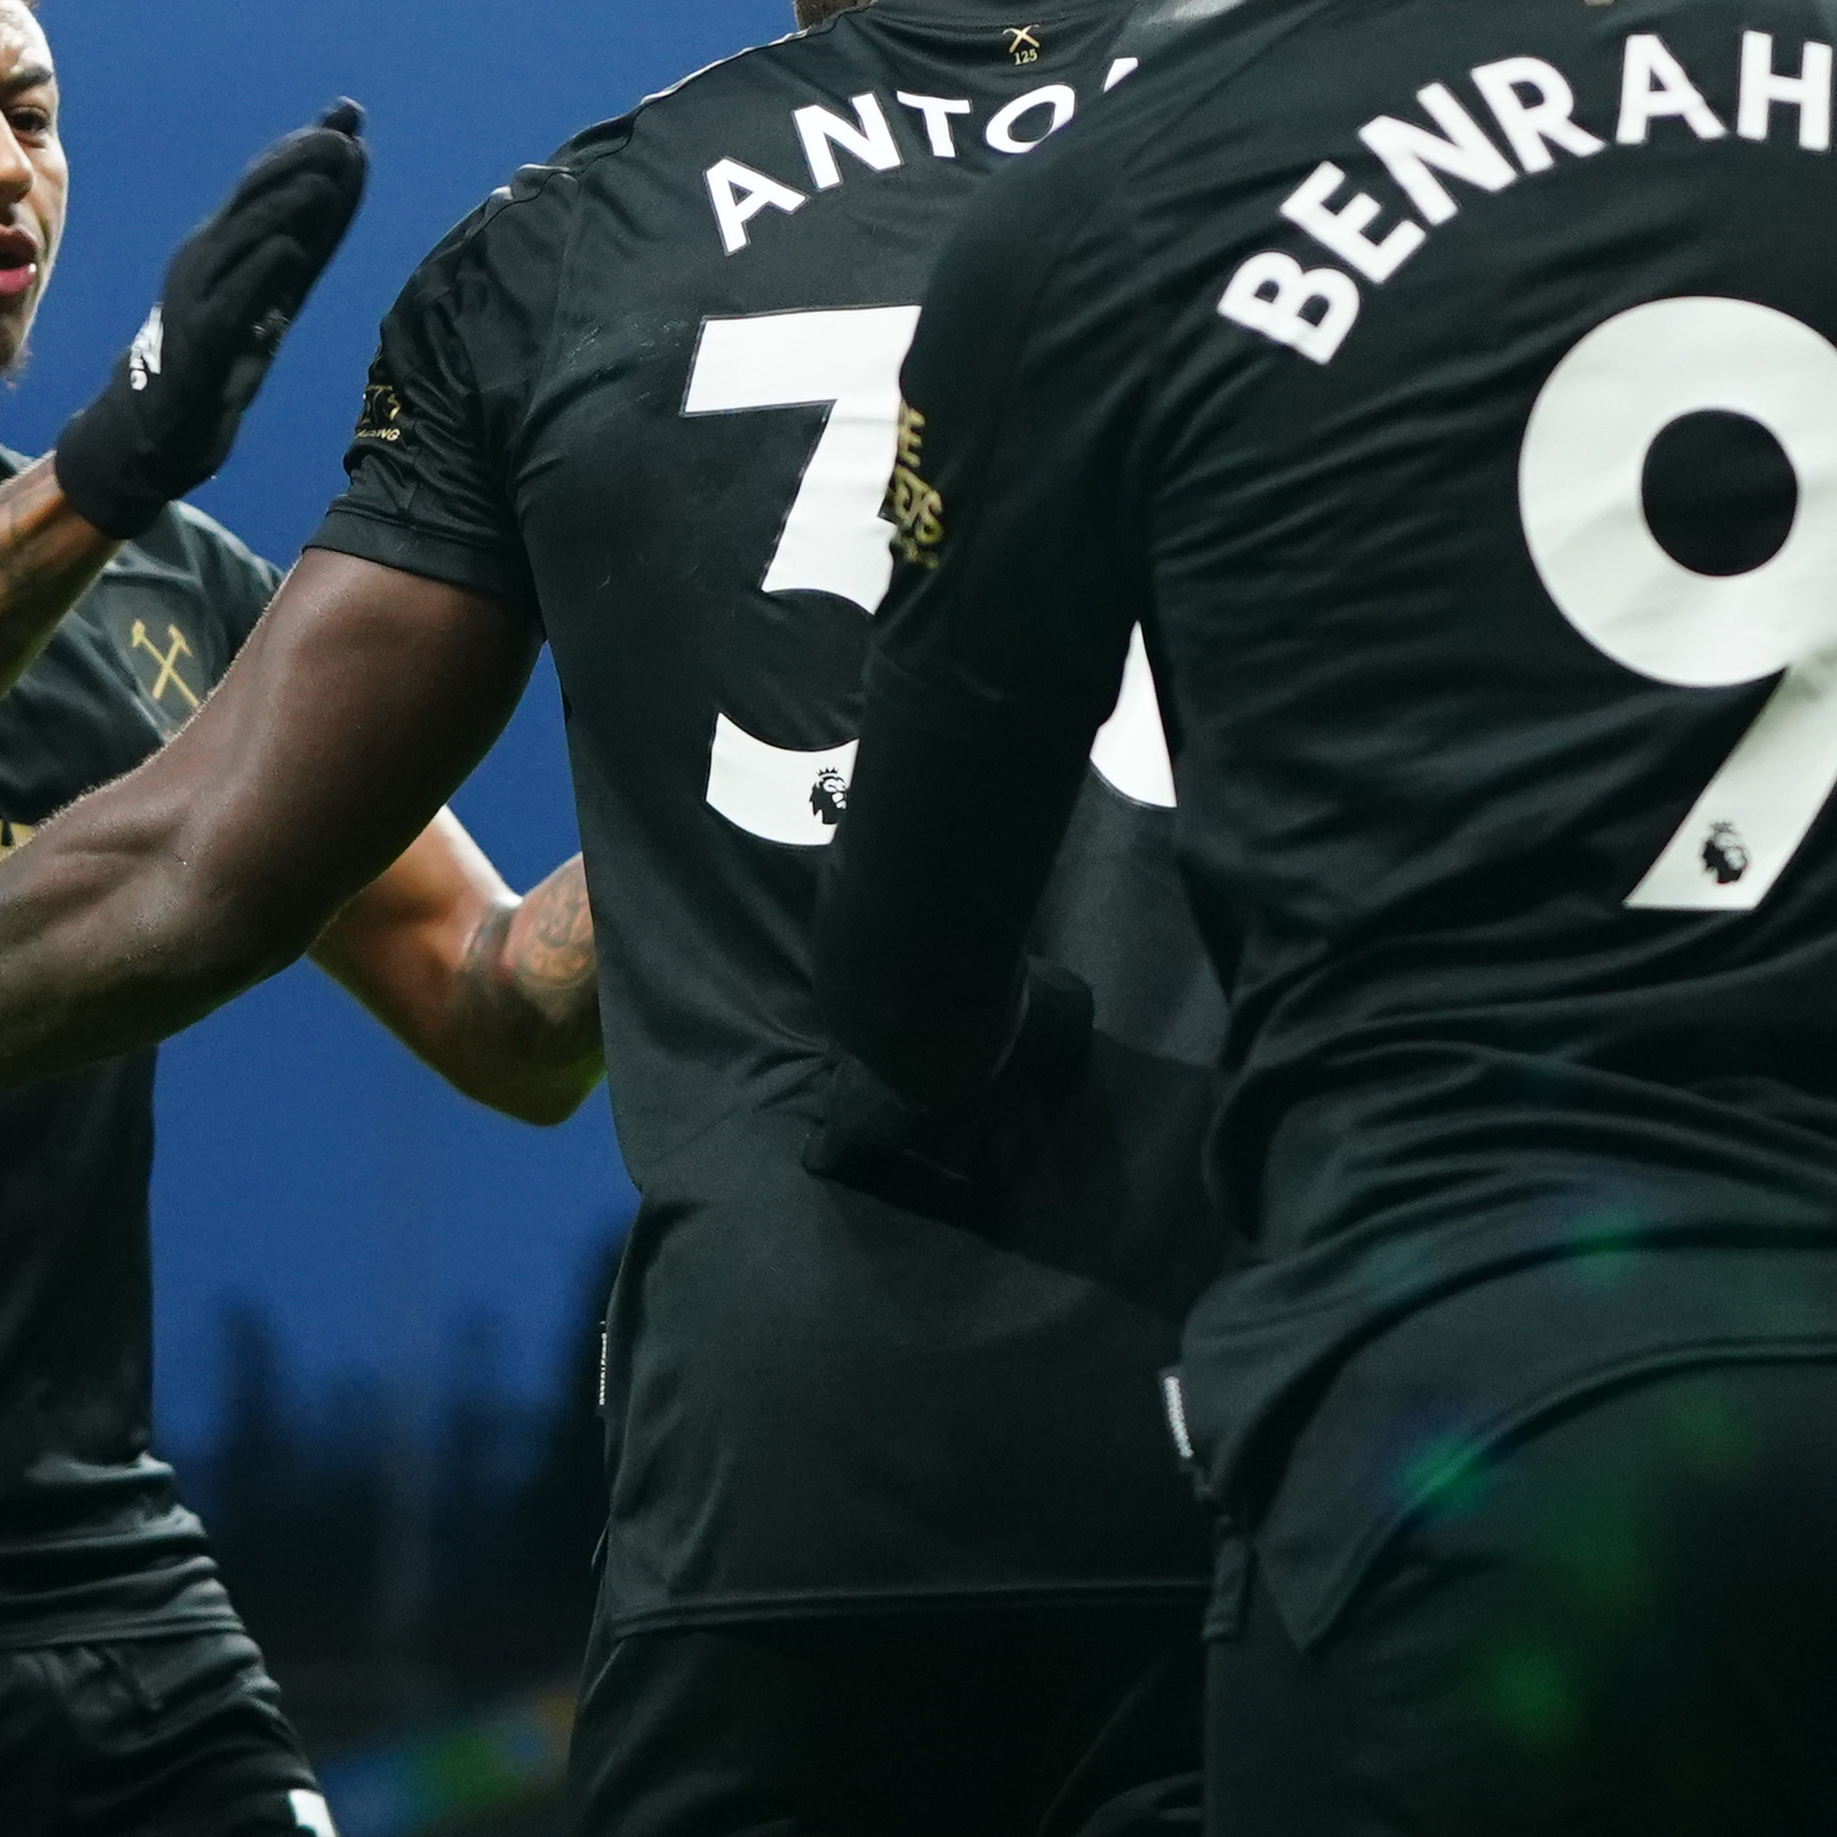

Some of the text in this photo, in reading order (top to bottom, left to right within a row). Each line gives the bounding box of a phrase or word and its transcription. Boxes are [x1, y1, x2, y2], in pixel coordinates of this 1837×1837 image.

[703, 57, 1139, 256] ANTO
[1014, 48, 1038, 66] 125
[681, 305, 1177, 845] 3
